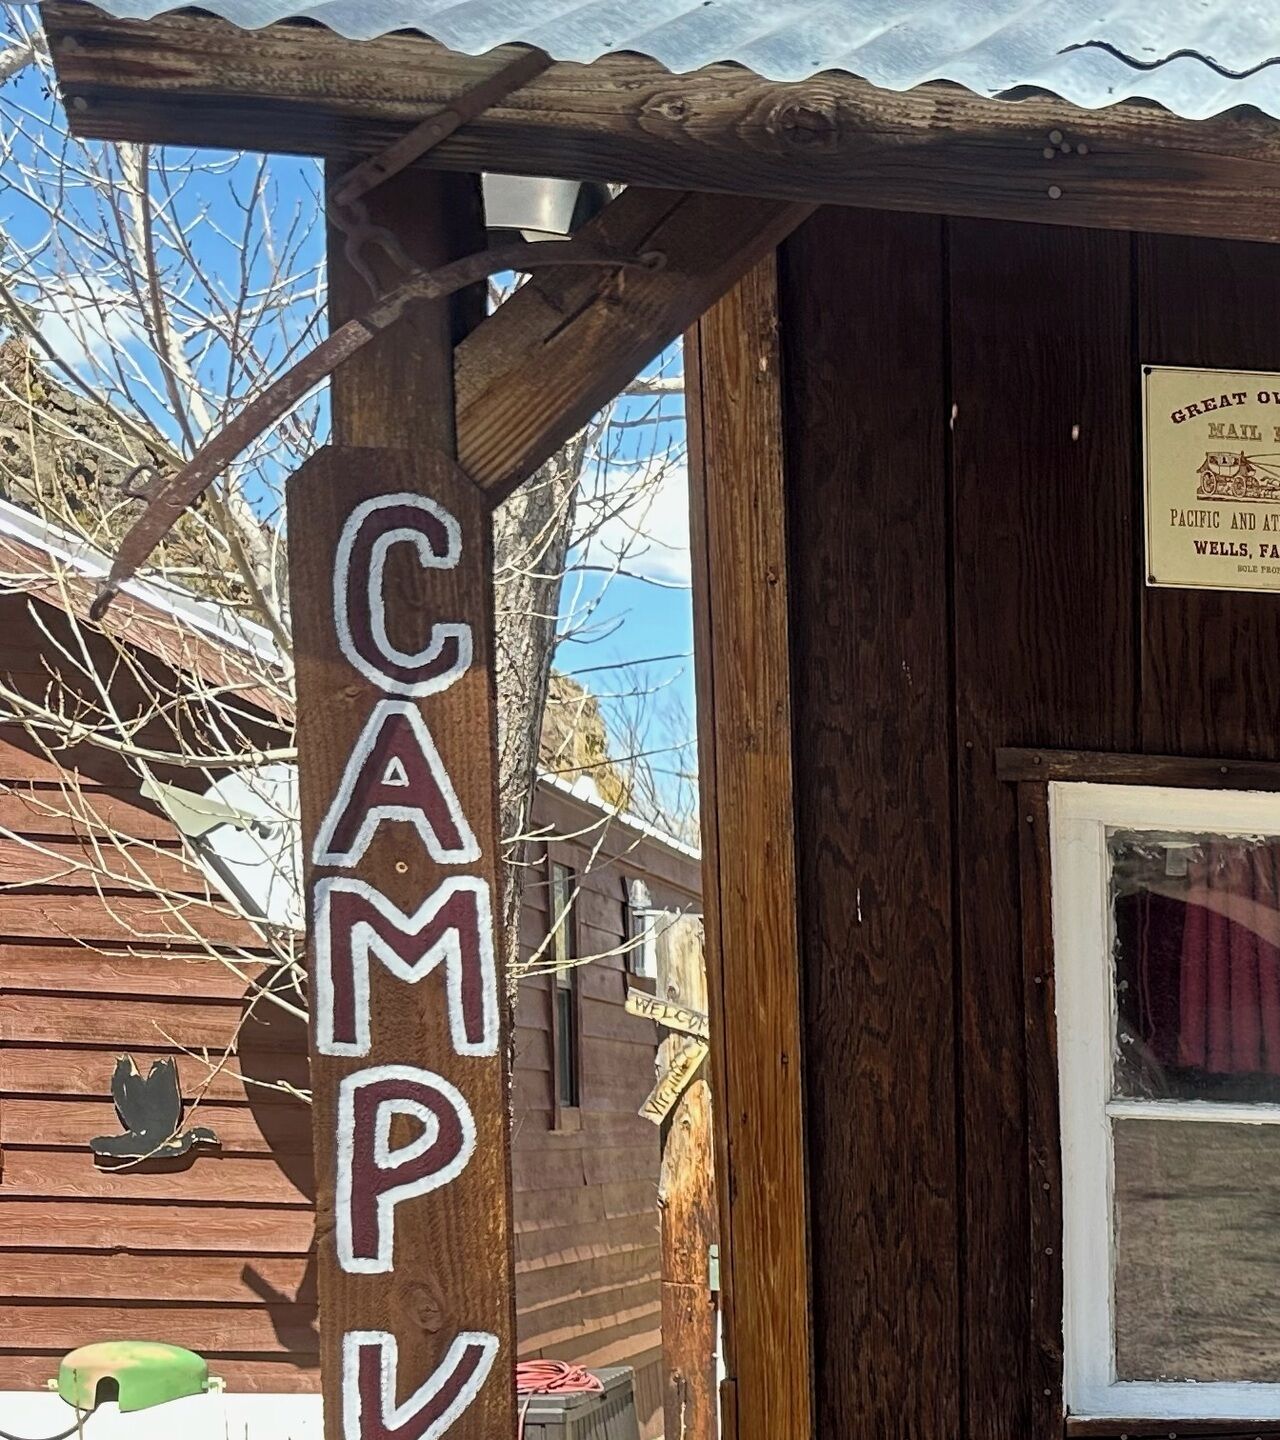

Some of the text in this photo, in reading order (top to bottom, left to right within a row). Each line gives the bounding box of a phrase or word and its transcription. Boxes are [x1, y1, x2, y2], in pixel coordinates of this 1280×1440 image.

[1170, 391, 1247, 423] GREAT
[1207, 422, 1262, 441] MAIL
[1169, 508, 1220, 529] PACIFIC
[1231, 512, 1256, 531] AND
[1193, 540, 1253, 560] WELLS,
[314, 492, 499, 1274] CAMP
[635, 996, 708, 1030] WELCOM
